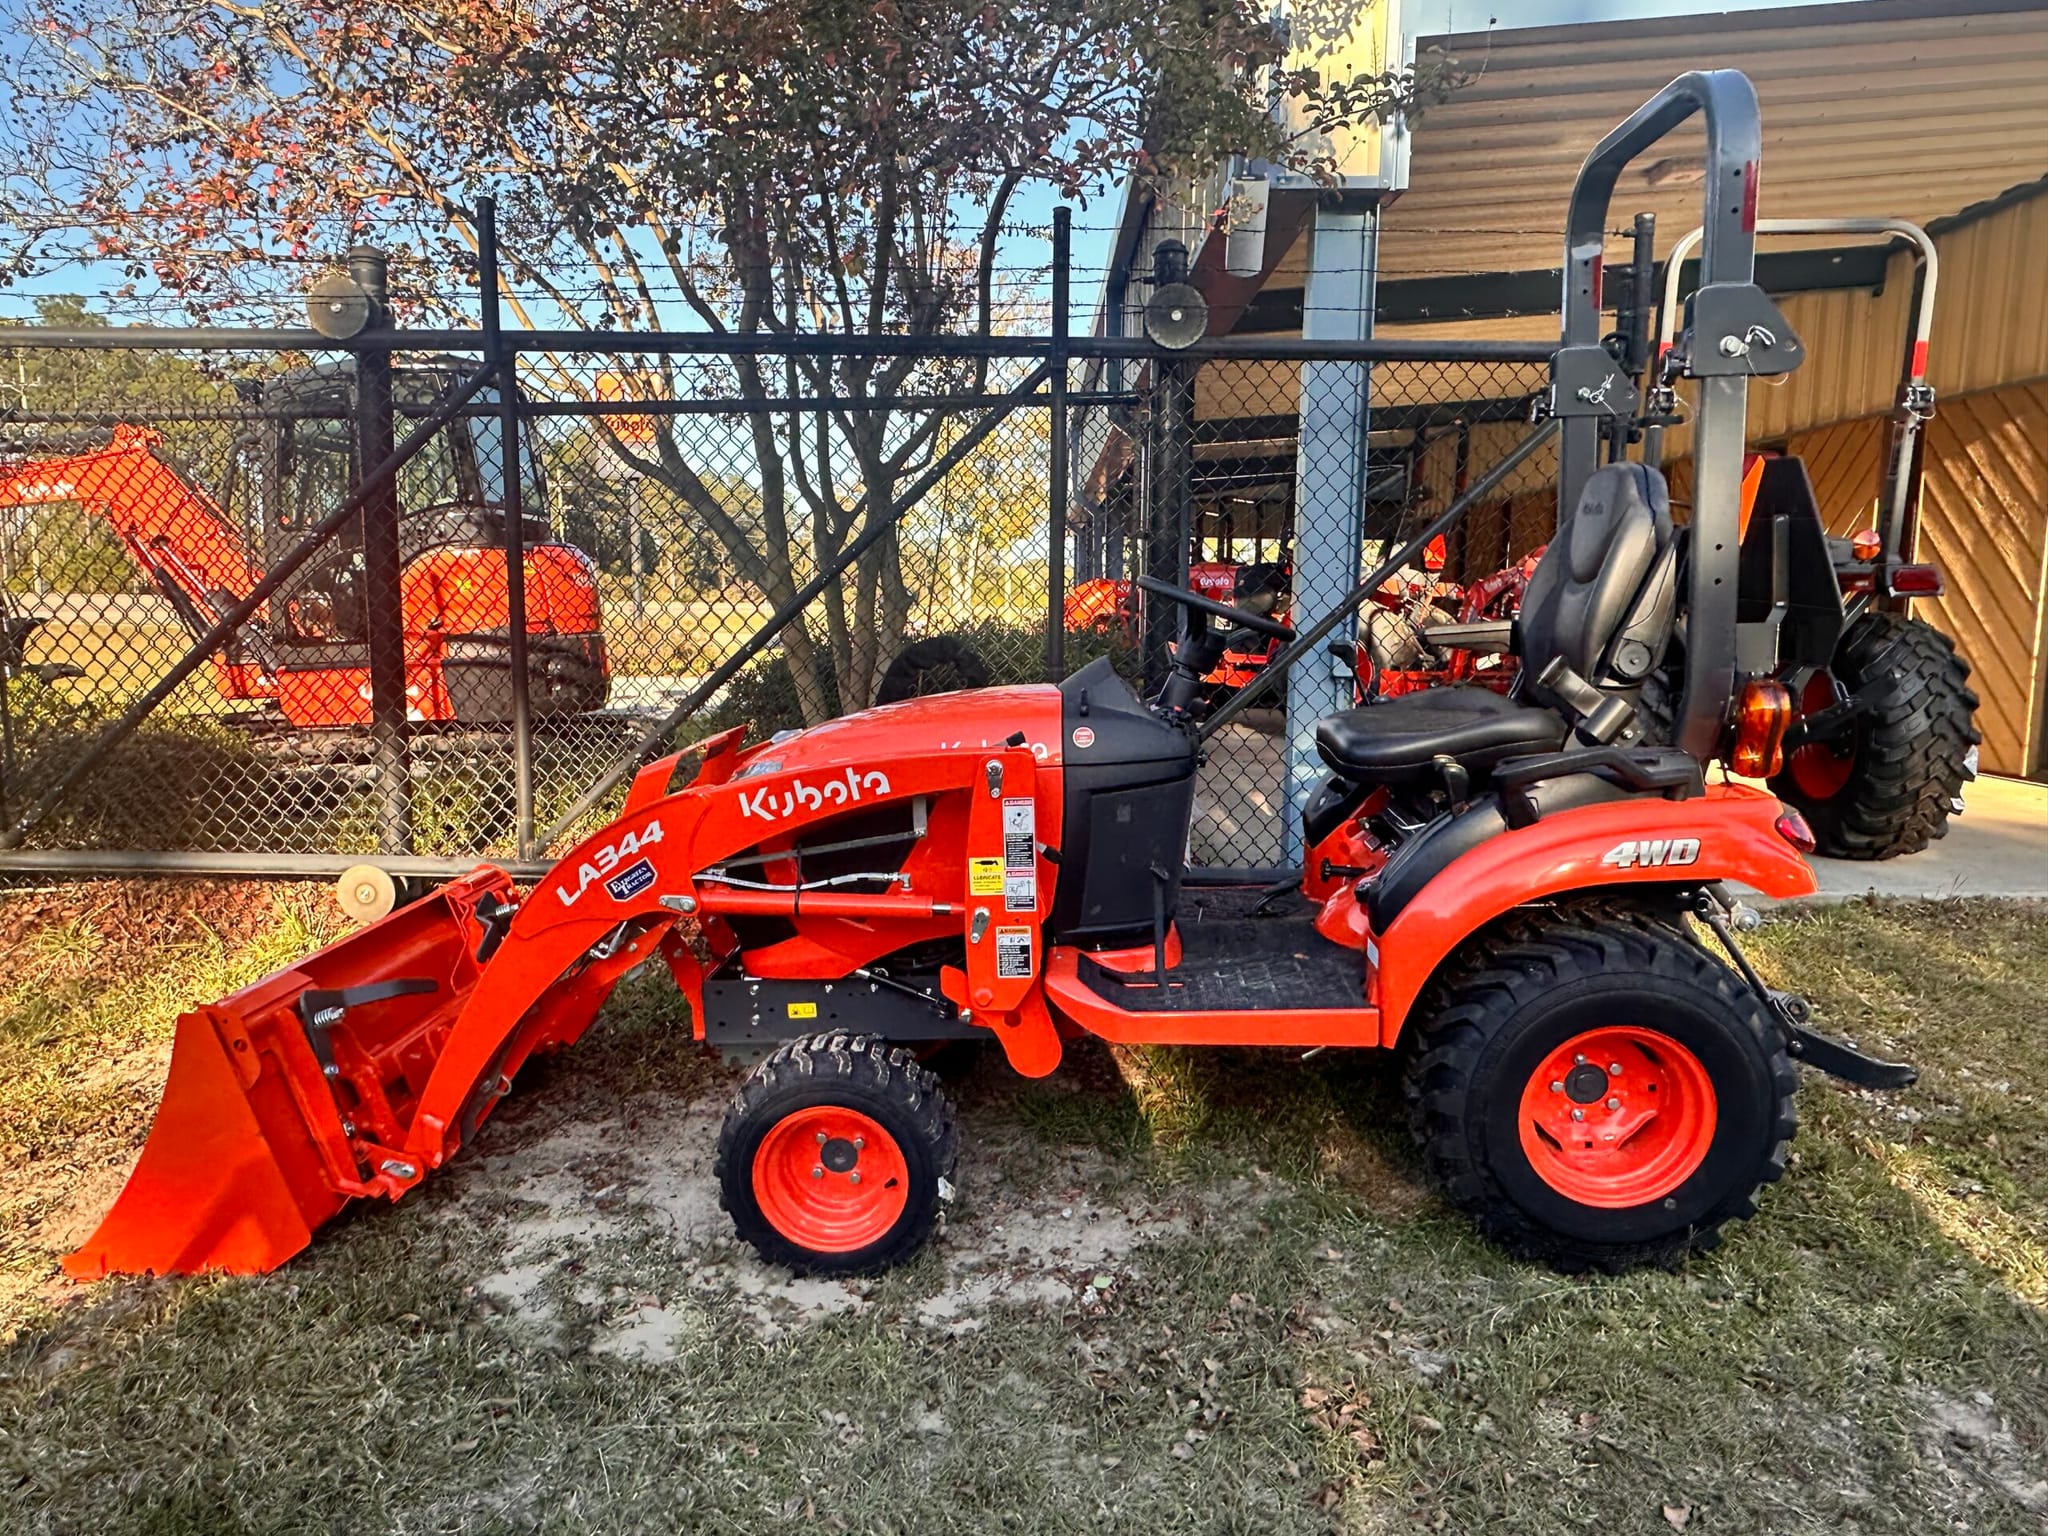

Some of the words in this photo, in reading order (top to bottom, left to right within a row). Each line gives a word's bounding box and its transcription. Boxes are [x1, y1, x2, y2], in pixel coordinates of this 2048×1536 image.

[738, 767, 892, 822] Kubota
[556, 820, 665, 906] LA344
[1601, 838, 1701, 868] 4WD
